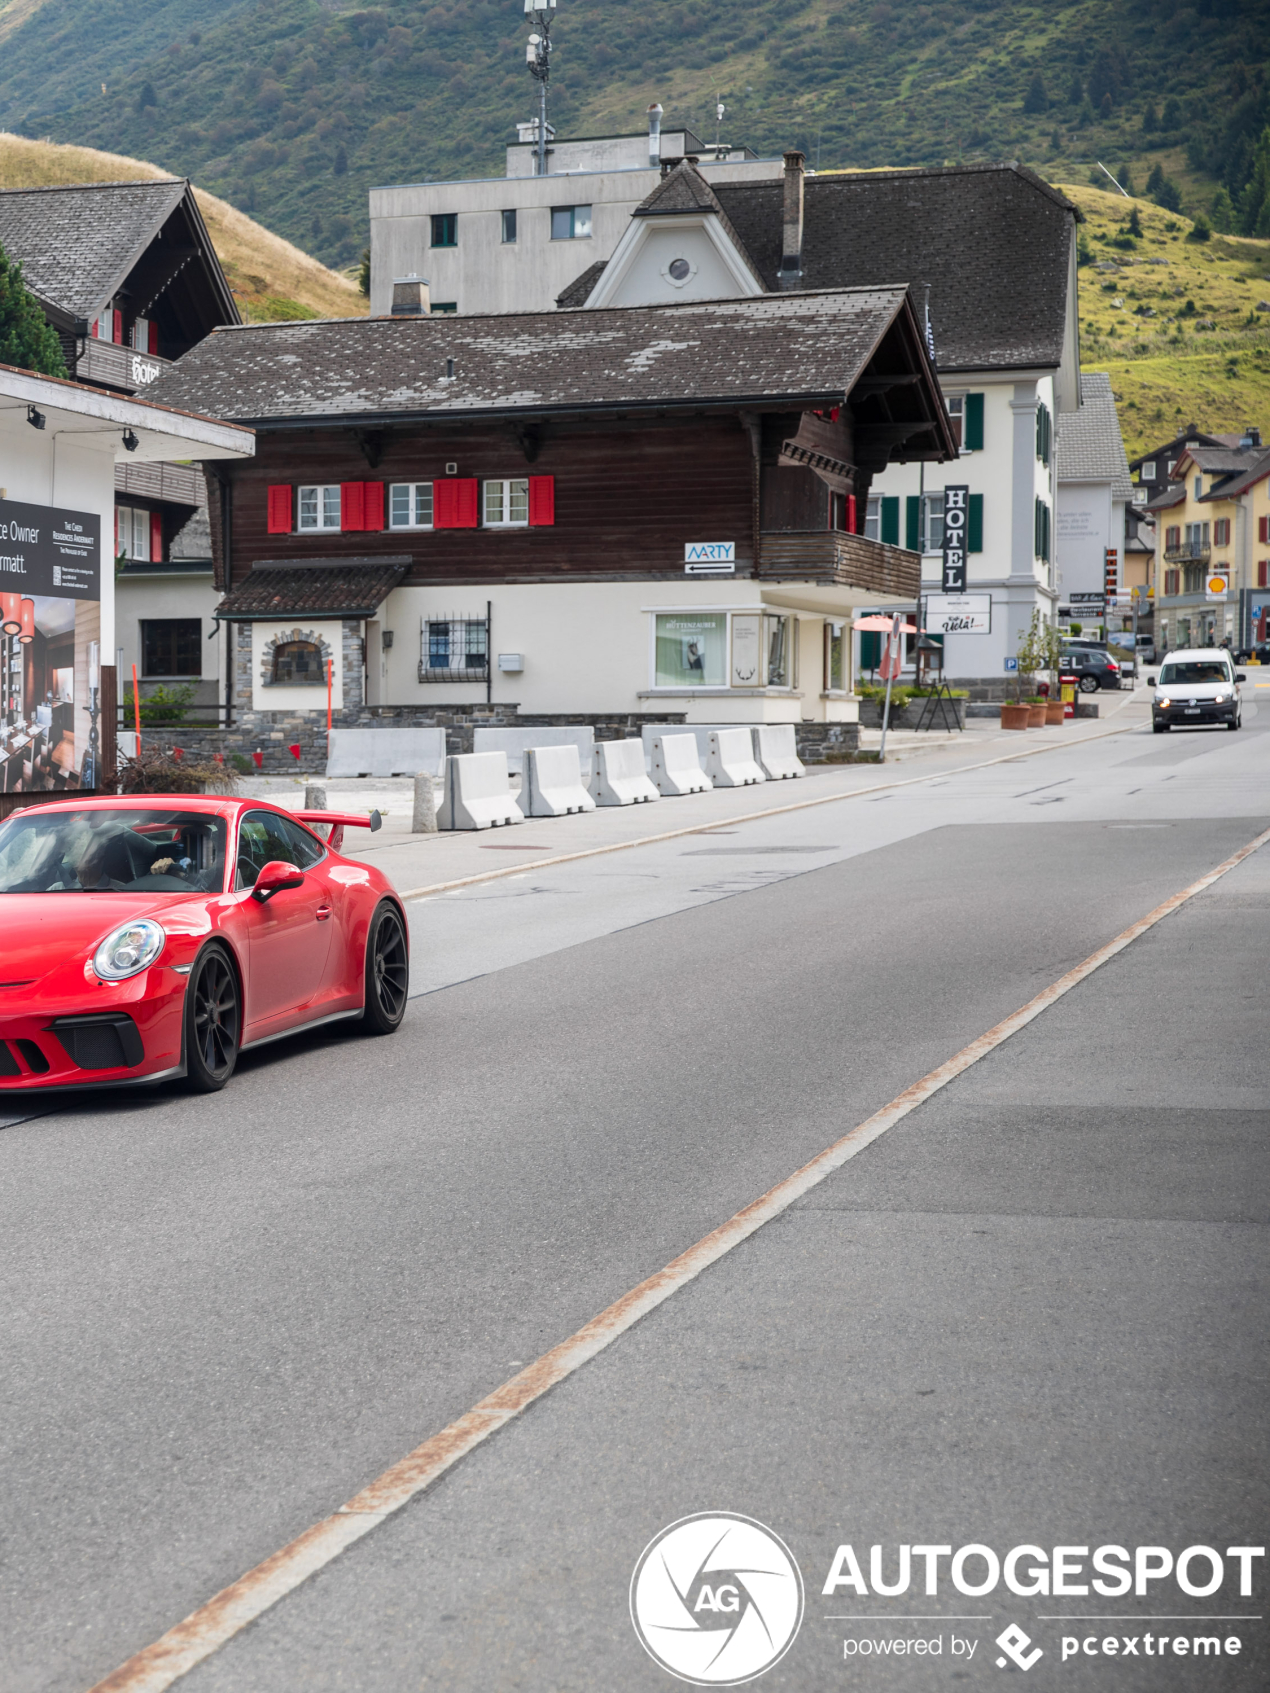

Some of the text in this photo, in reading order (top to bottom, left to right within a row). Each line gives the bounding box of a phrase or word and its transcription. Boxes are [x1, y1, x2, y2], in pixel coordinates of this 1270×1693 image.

[10, 520, 39, 543] Owner
[945, 490, 966, 587] HOTEL
[687, 544, 732, 560] MARTY
[1107, 549, 1117, 596] HOTEL
[1007, 659, 1016, 669] P
